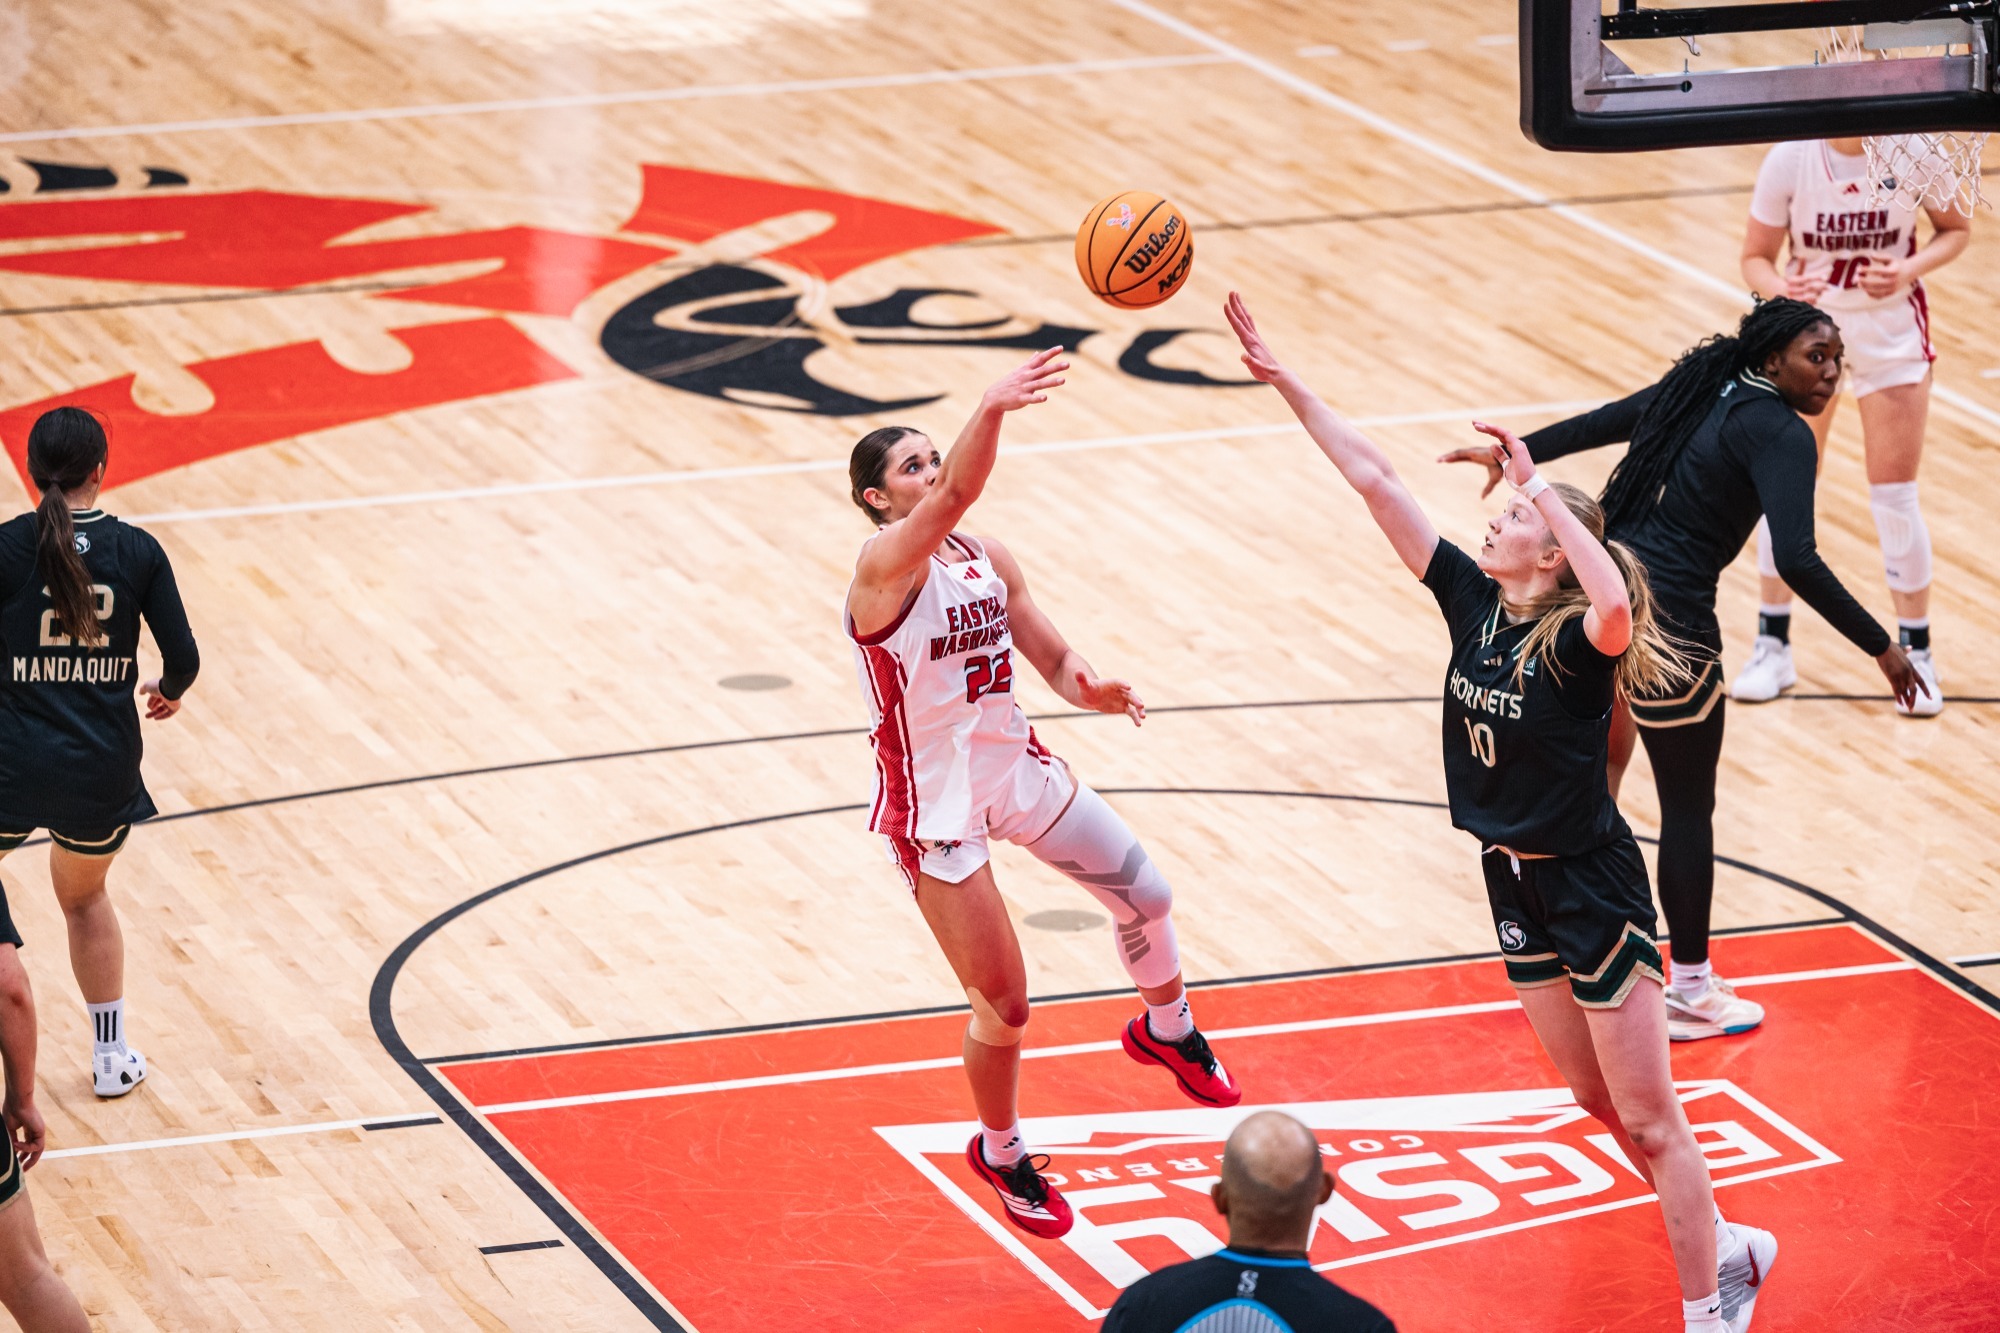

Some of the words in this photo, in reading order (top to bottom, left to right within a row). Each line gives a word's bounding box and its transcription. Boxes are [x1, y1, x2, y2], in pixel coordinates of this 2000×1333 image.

[1124, 215, 1180, 274] Wilson
[1802, 227, 1900, 252] WASHINGTON
[1816, 210, 1889, 233] EASTERN
[13, 656, 132, 685] MANDAQUIT
[963, 648, 1012, 704] 22
[1450, 668, 1524, 720] HORNETS
[1464, 716, 1496, 768] 10
